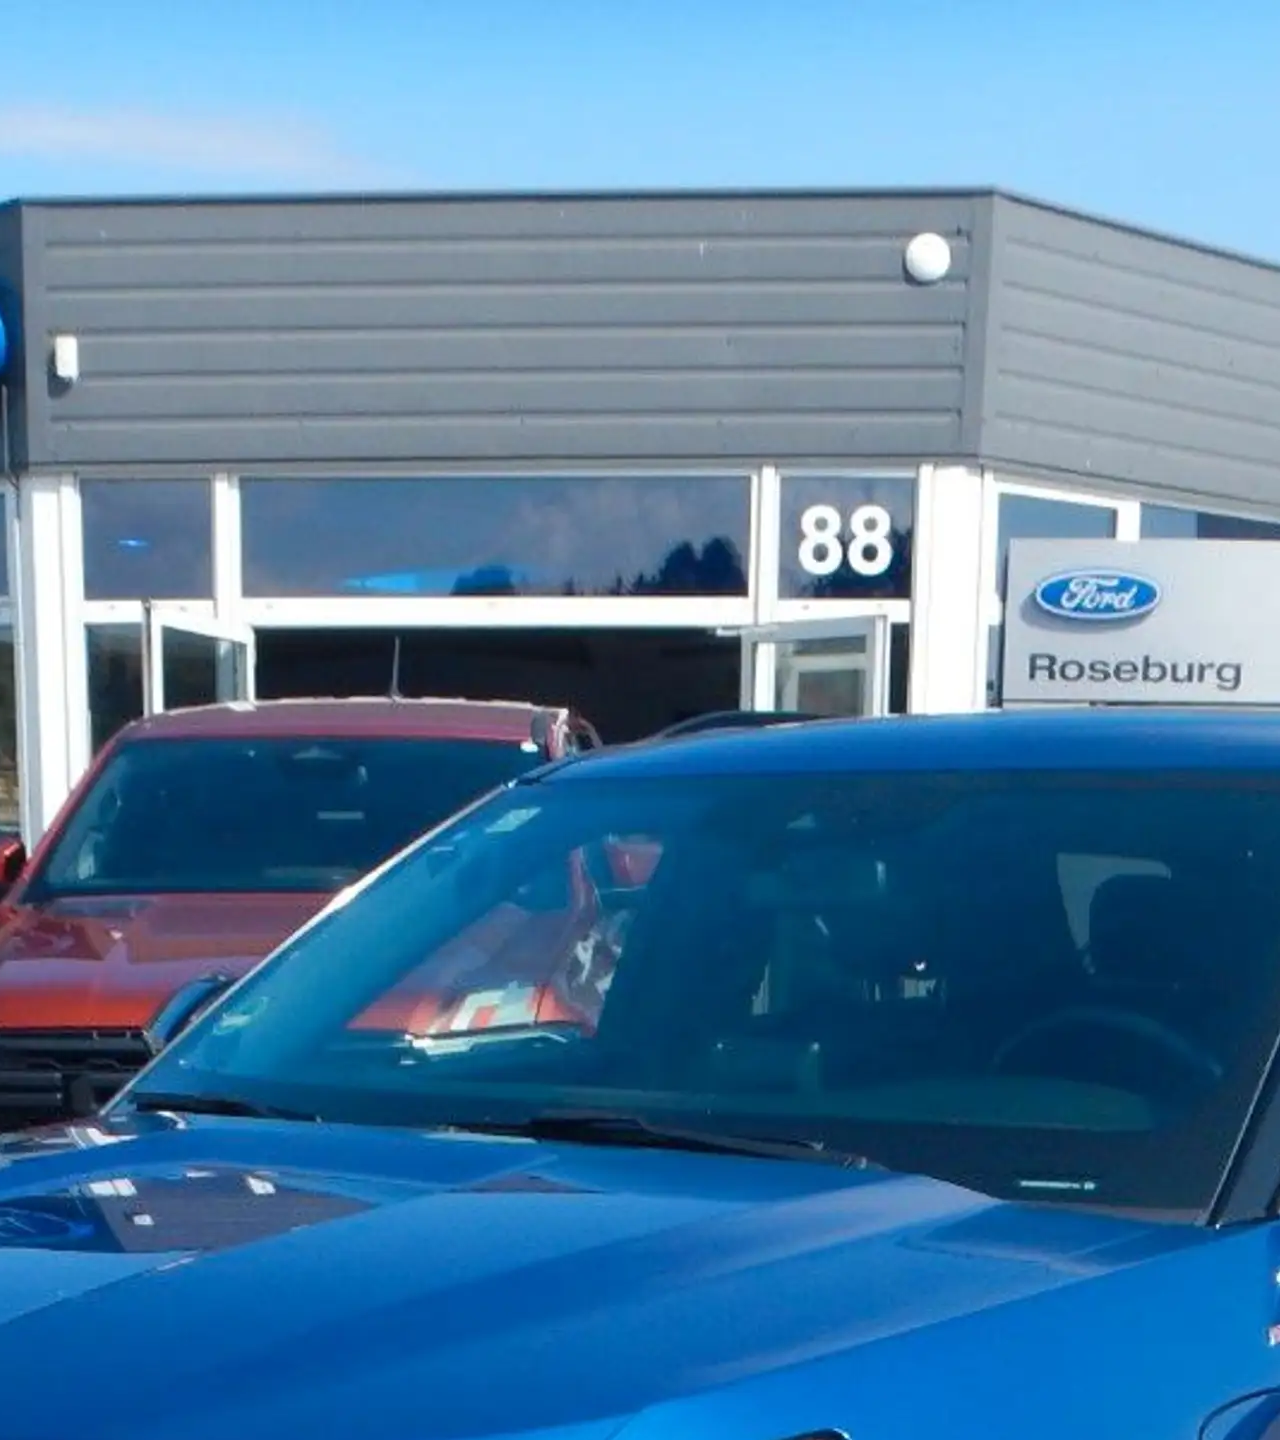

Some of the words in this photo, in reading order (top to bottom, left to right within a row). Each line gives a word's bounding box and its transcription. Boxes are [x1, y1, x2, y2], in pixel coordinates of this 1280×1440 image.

[798, 504, 894, 576] 88
[1060, 576, 1138, 609] Ford
[1029, 653, 1242, 691] Roseburg
